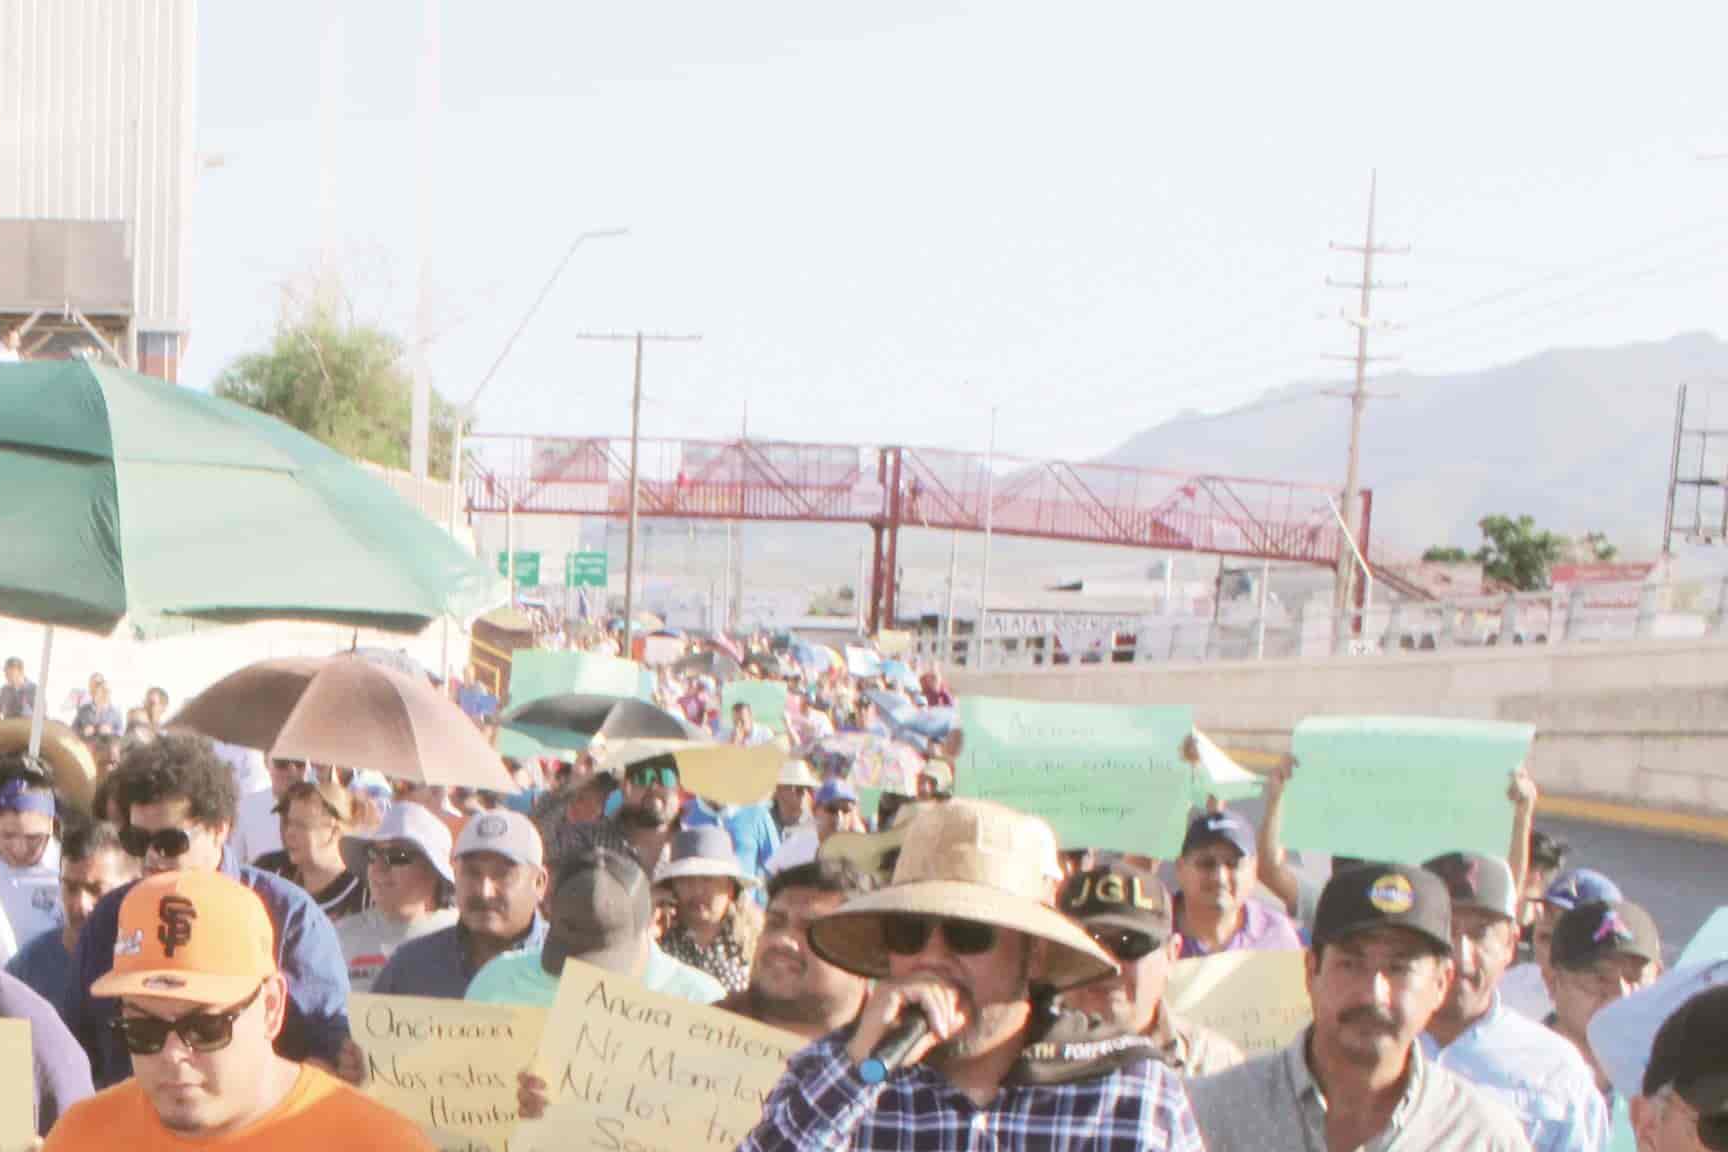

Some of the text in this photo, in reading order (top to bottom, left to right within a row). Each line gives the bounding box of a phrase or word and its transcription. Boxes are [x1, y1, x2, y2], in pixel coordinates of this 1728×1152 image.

[1072, 874, 1152, 910] JGL
[559, 1062, 609, 1104] Ni
[574, 1021, 774, 1108] Ni Monclov
